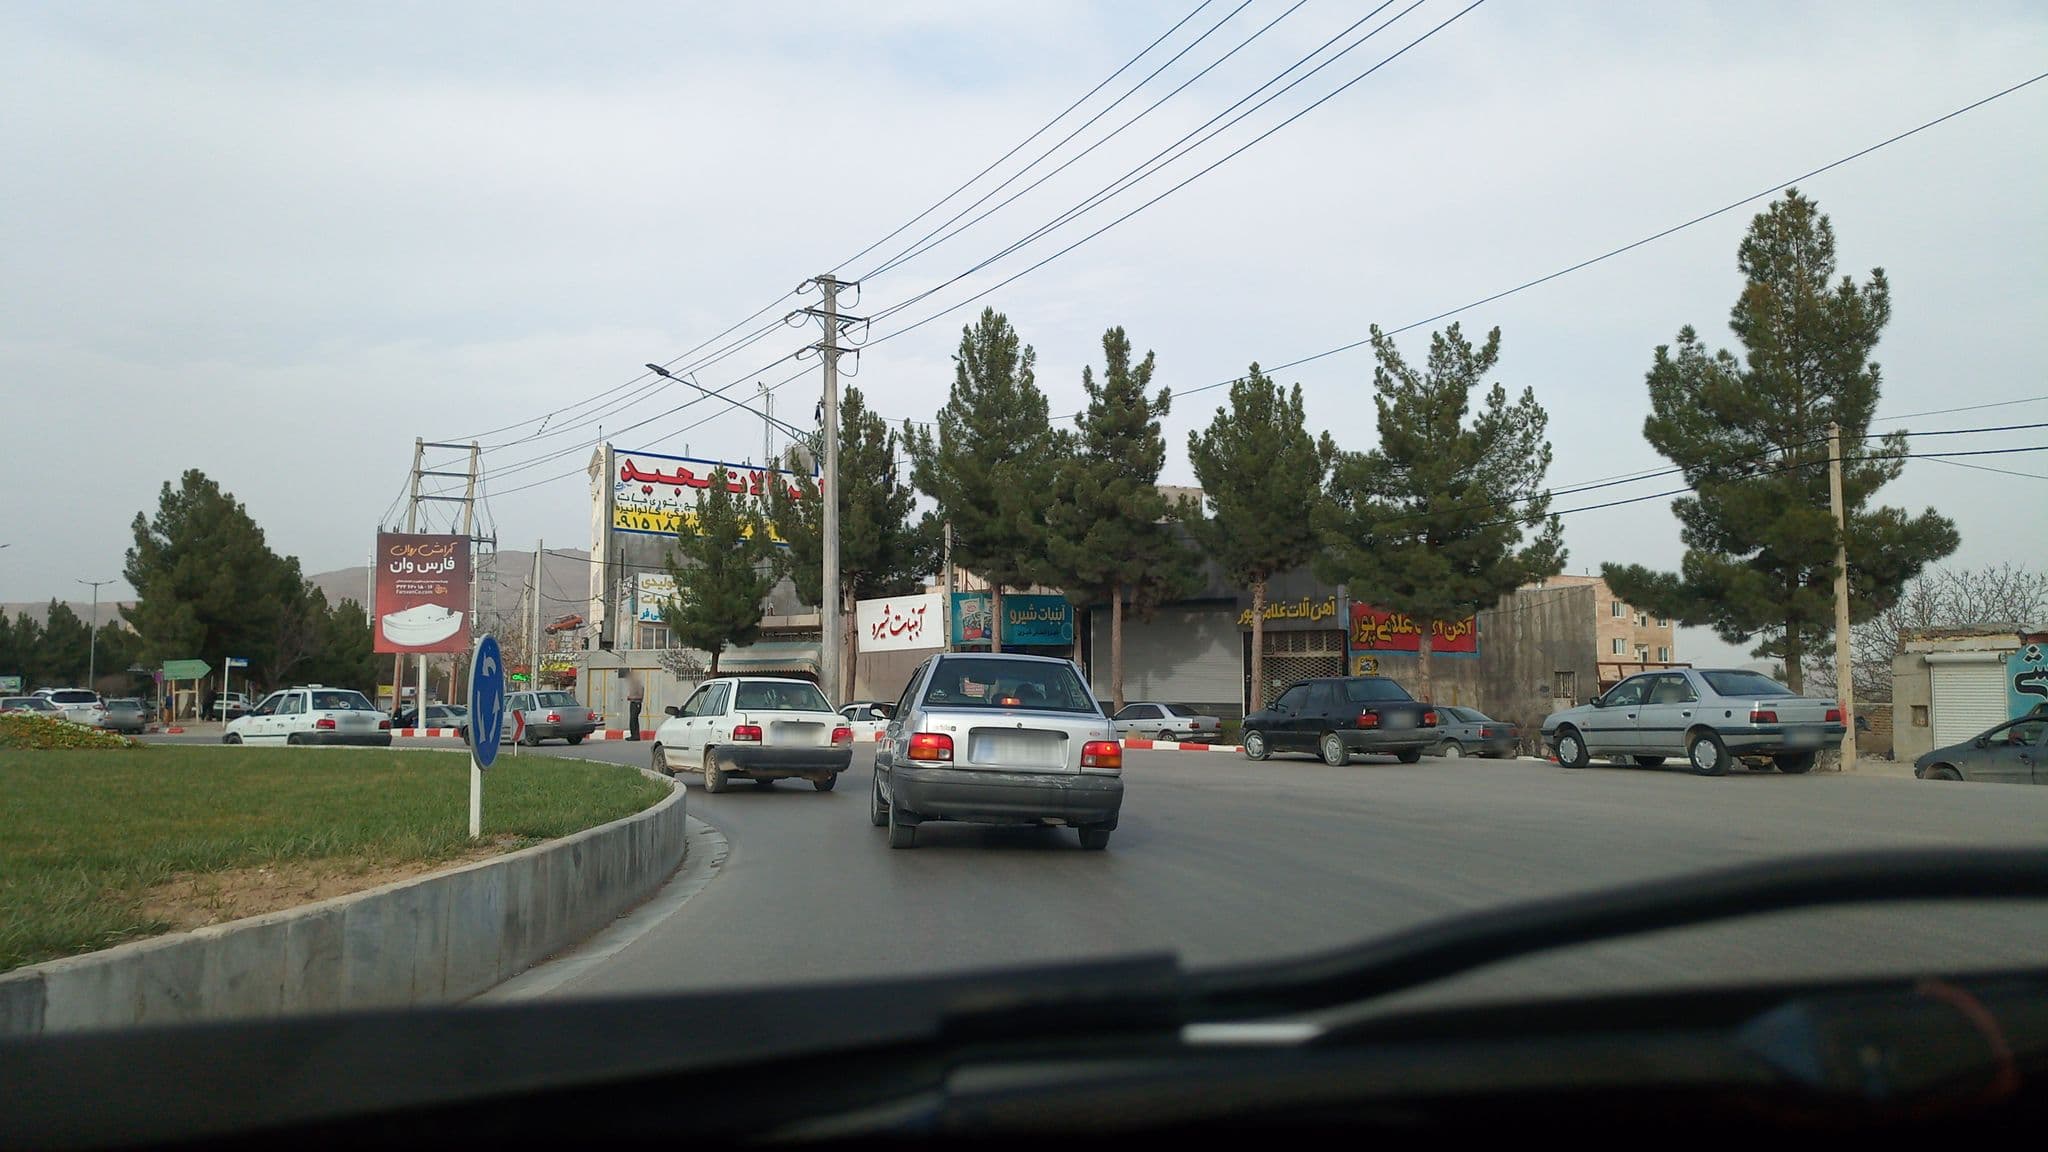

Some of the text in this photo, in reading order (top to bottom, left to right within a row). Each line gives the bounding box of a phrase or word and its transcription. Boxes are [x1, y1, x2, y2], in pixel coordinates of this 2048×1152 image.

[620, 458, 716, 497] مجید
[390, 556, 456, 574] فارس وان
[1009, 603, 1067, 625] آبنبات شیرو
[1262, 600, 1287, 621] غلام
[1286, 597, 1310, 618] آلات
[1310, 596, 1336, 621] آهن
[889, 603, 927, 642] آبنبات
[1445, 614, 1475, 641] آهن
